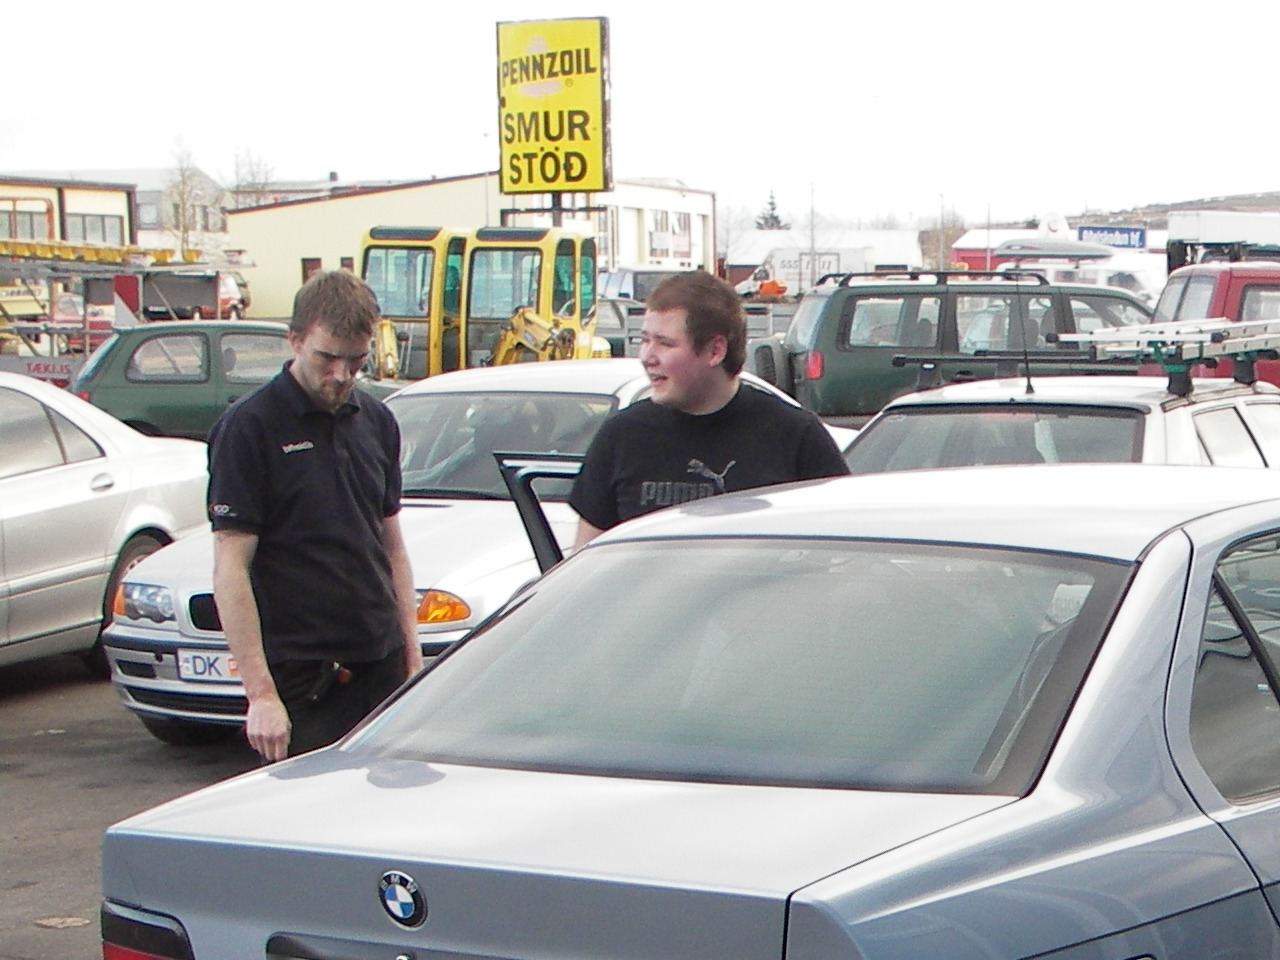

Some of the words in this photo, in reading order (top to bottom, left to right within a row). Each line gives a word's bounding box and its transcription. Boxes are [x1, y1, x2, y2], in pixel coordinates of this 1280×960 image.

[502, 47, 597, 87] PENNZOIL
[504, 110, 591, 144] SMUR
[192, 655, 222, 677] DK
